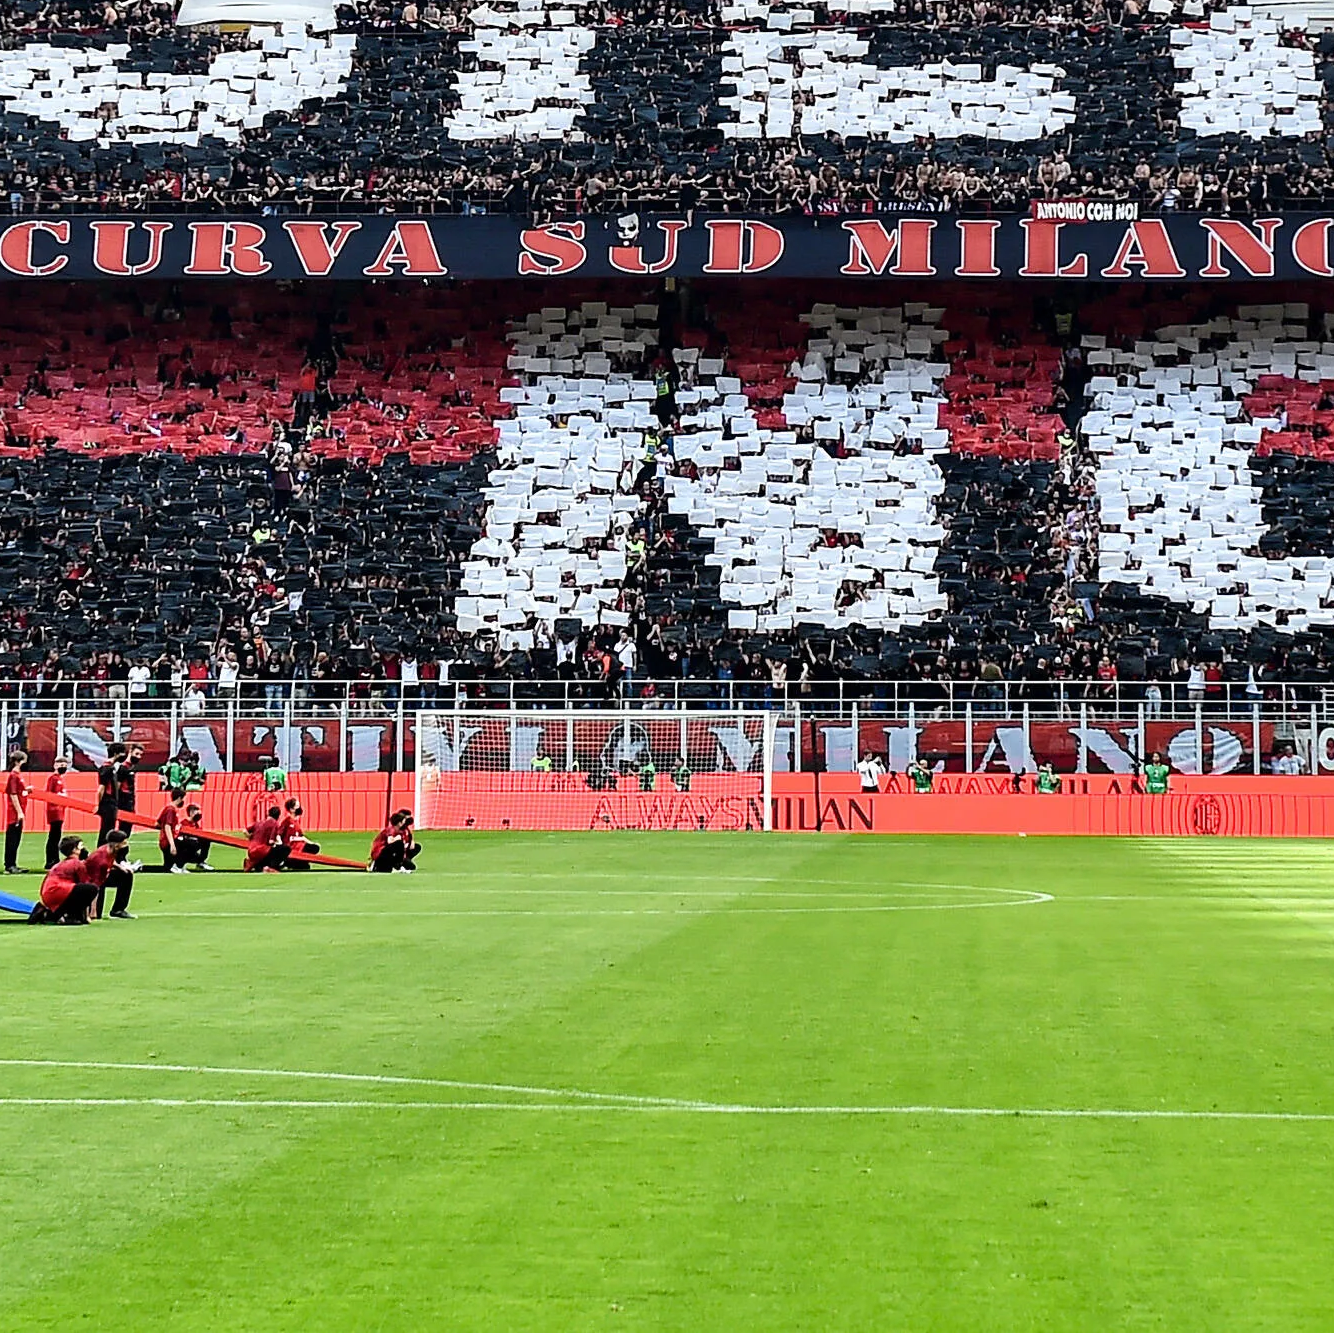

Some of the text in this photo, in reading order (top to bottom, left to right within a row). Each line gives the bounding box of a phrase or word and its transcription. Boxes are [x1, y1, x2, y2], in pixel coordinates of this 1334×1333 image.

[1037, 202, 1138, 220] ANTONIO CON NOI
[517, 219, 785, 276] SUD
